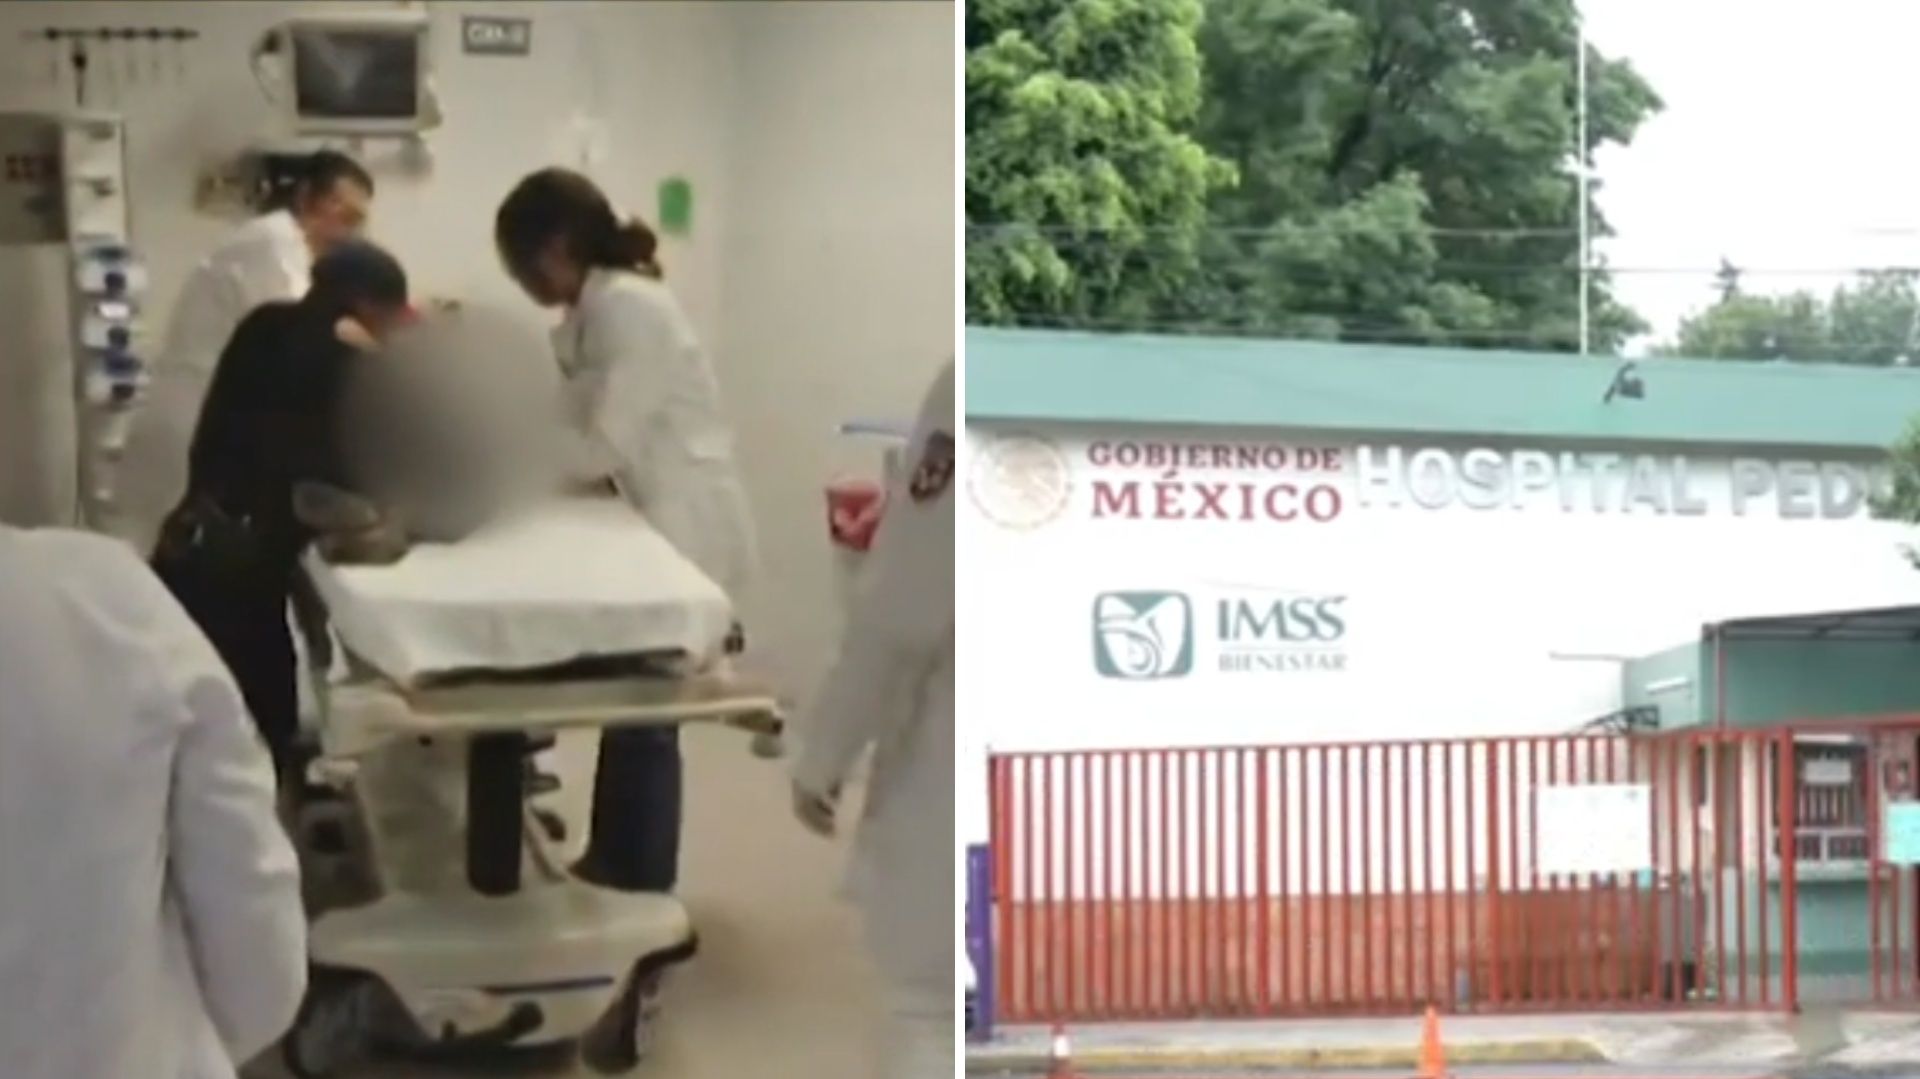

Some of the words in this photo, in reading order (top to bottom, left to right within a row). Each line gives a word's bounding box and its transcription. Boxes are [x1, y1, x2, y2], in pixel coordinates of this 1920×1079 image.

[1088, 441, 1288, 469] GOBIERNO
[1296, 448, 1343, 470] DE
[1091, 471, 1342, 522] MÉXICO
[1357, 446, 1707, 517] HOSPITAL
[1218, 597, 1346, 641] IMSS
[1218, 653, 1346, 672] BIENESTAR
